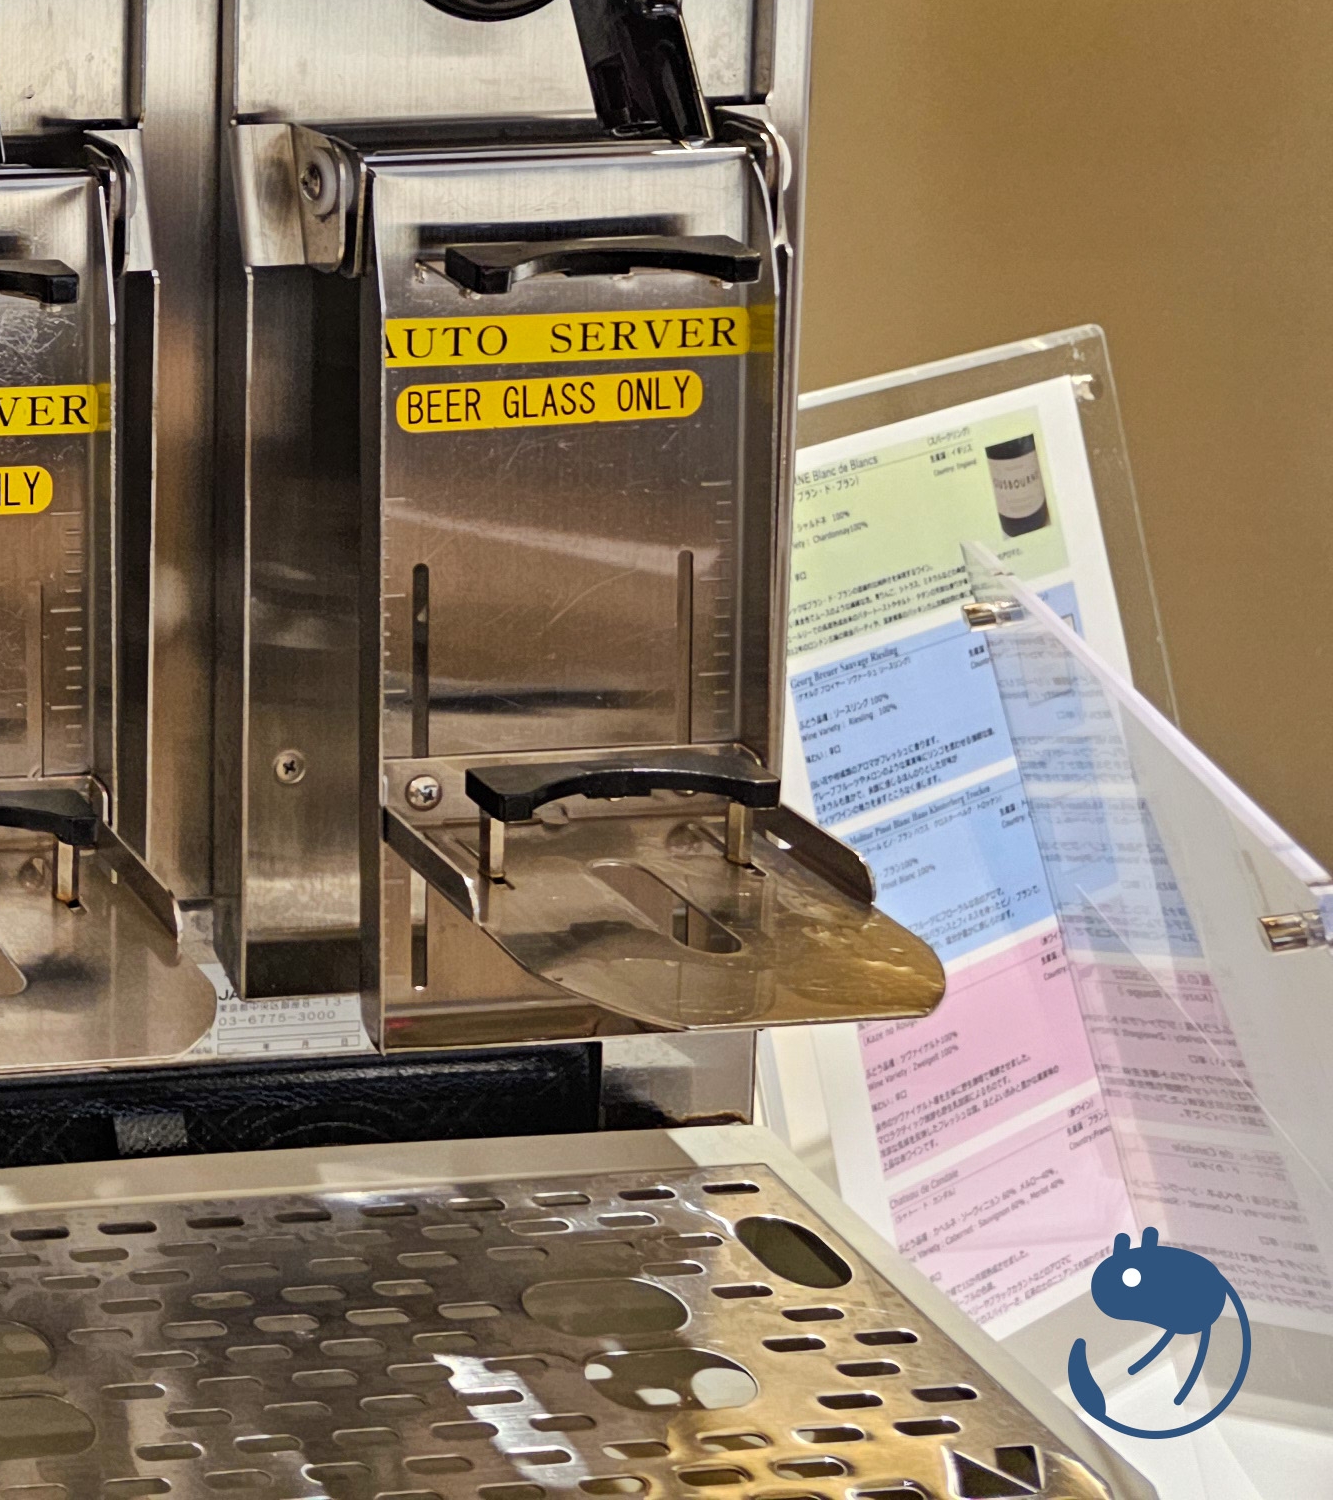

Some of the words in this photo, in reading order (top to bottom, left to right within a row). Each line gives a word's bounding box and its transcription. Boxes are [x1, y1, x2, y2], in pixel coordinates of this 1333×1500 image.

[550, 316, 738, 353] SERVER
[408, 389, 481, 424] BEER
[503, 382, 595, 419] GLASS
[617, 375, 691, 412] ONLY
[811, 465, 836, 481] Blanc
[836, 461, 848, 474] de
[848, 452, 878, 471] Blancs
[789, 674, 813, 693] Georg
[869, 644, 899, 664] Riesling
[218, 1009, 336, 1026] 03-6775-3000
